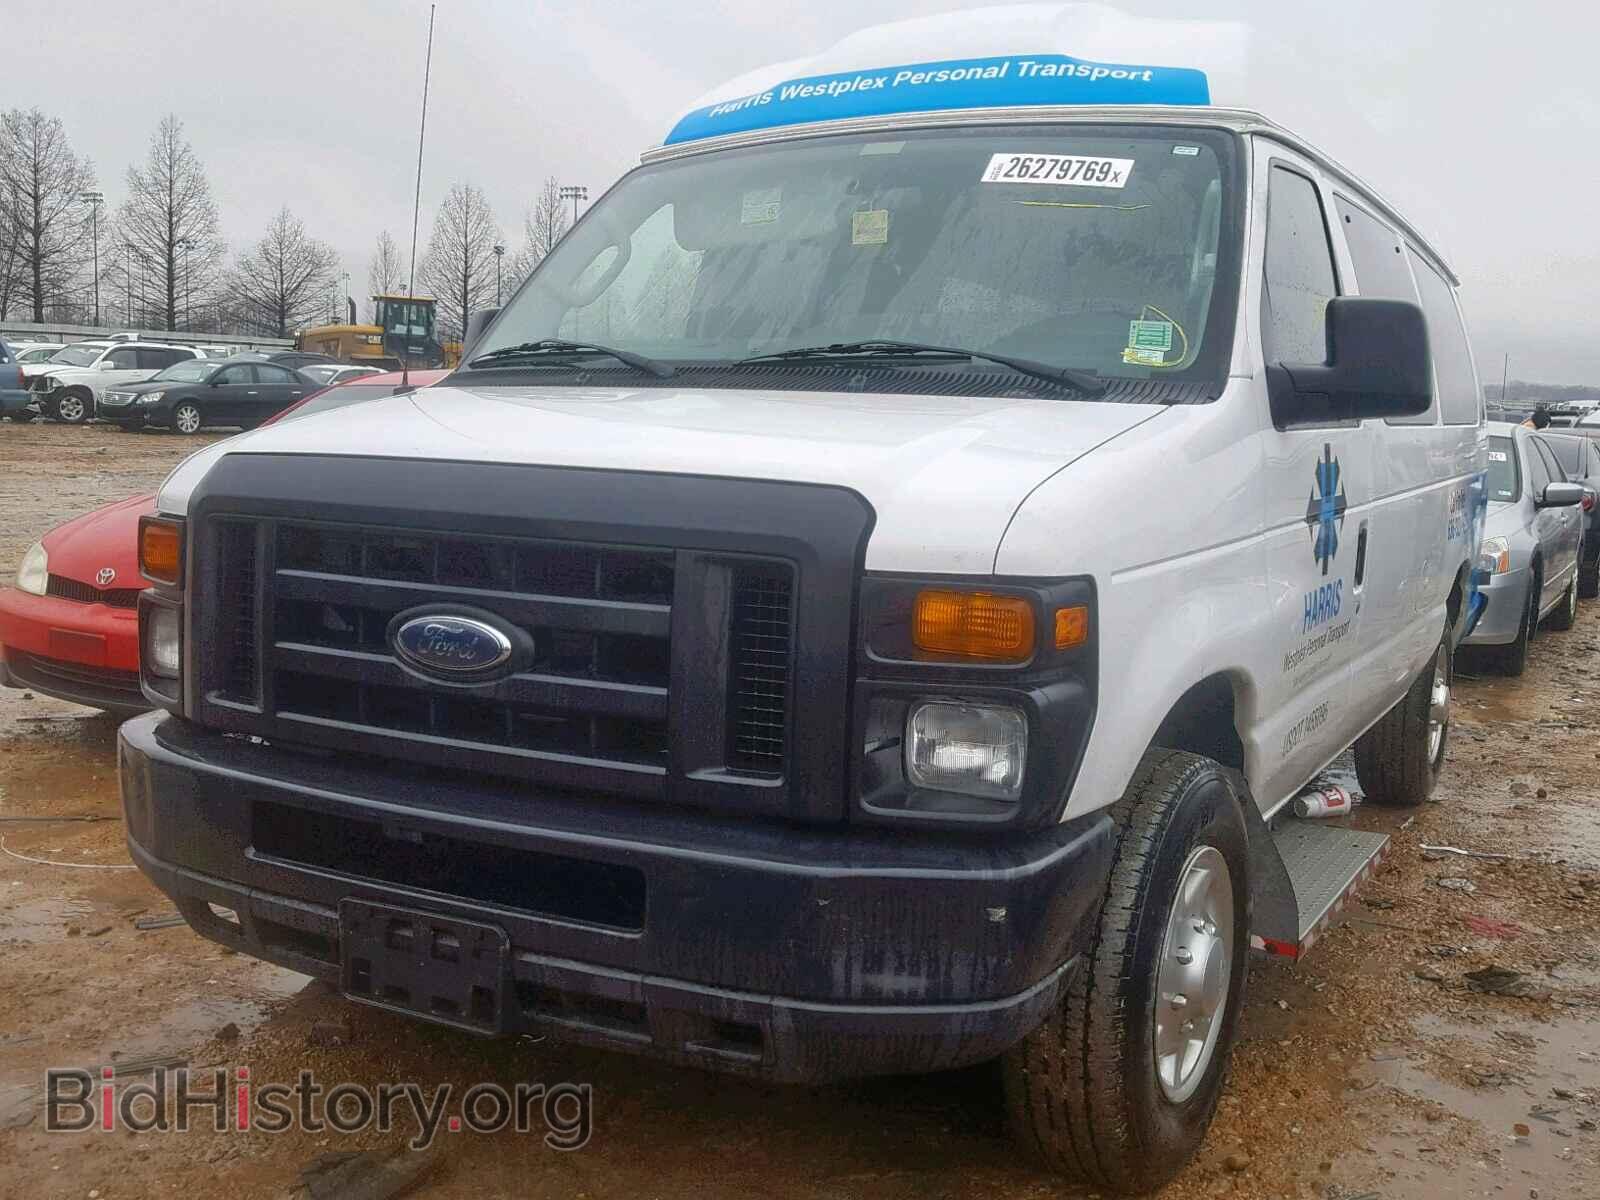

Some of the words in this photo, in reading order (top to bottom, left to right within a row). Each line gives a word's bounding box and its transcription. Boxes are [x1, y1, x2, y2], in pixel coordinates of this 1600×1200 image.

[709, 90, 772, 118] Harris
[780, 76, 886, 102] Westplex
[893, 63, 1008, 88] Personal
[1016, 60, 1154, 82] Transport
[1302, 578, 1343, 634] HARRIS
[417, 623, 479, 660] Ford
